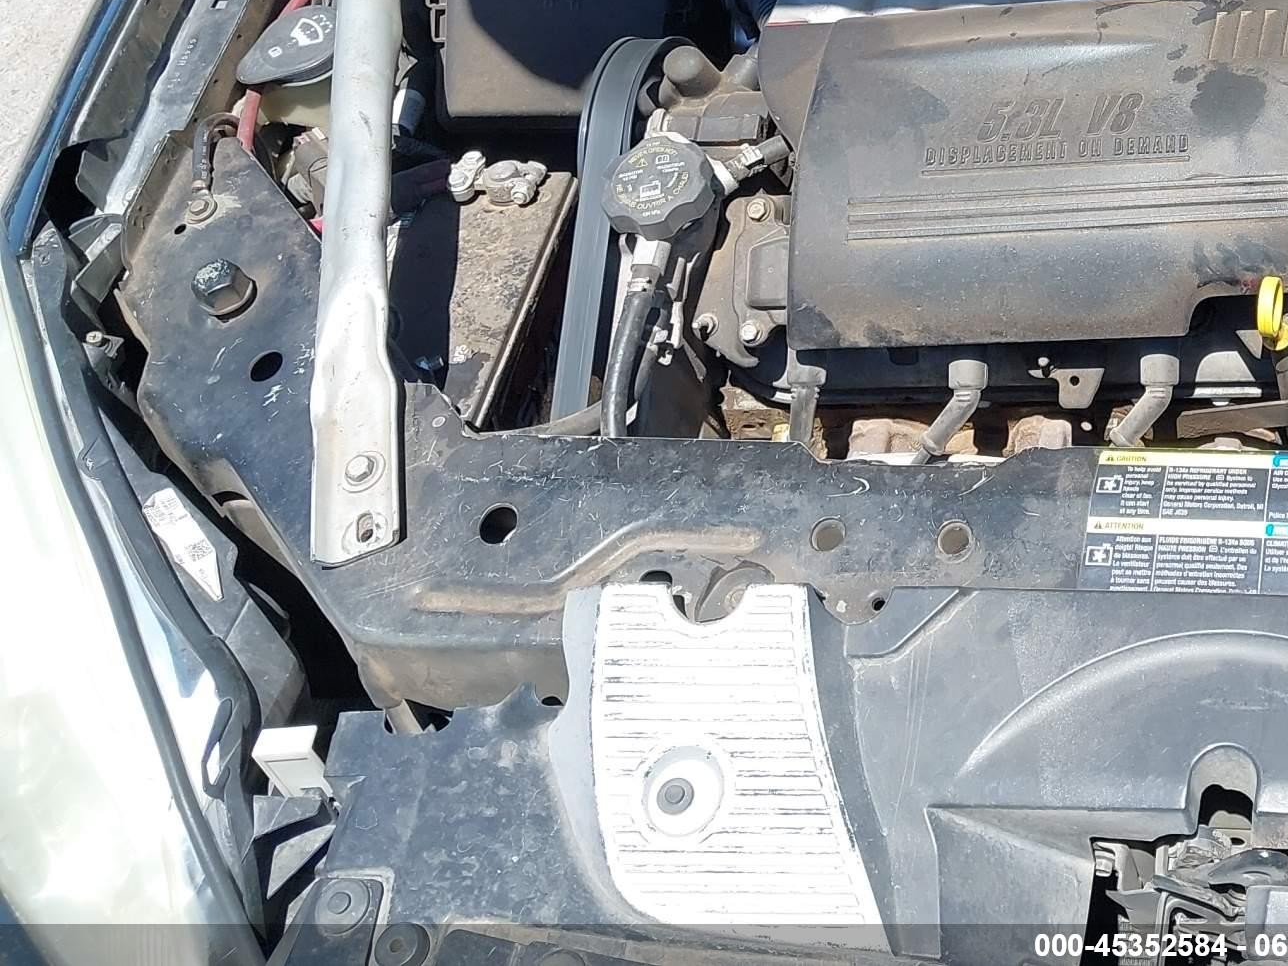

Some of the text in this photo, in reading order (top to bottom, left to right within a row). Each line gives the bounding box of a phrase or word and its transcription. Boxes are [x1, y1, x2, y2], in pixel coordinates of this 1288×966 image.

[977, 93, 1144, 143] 5.3L V8
[925, 133, 1190, 166] DISPLACEMENT ON DEMAND
[1104, 521, 1144, 529] ATTENTION
